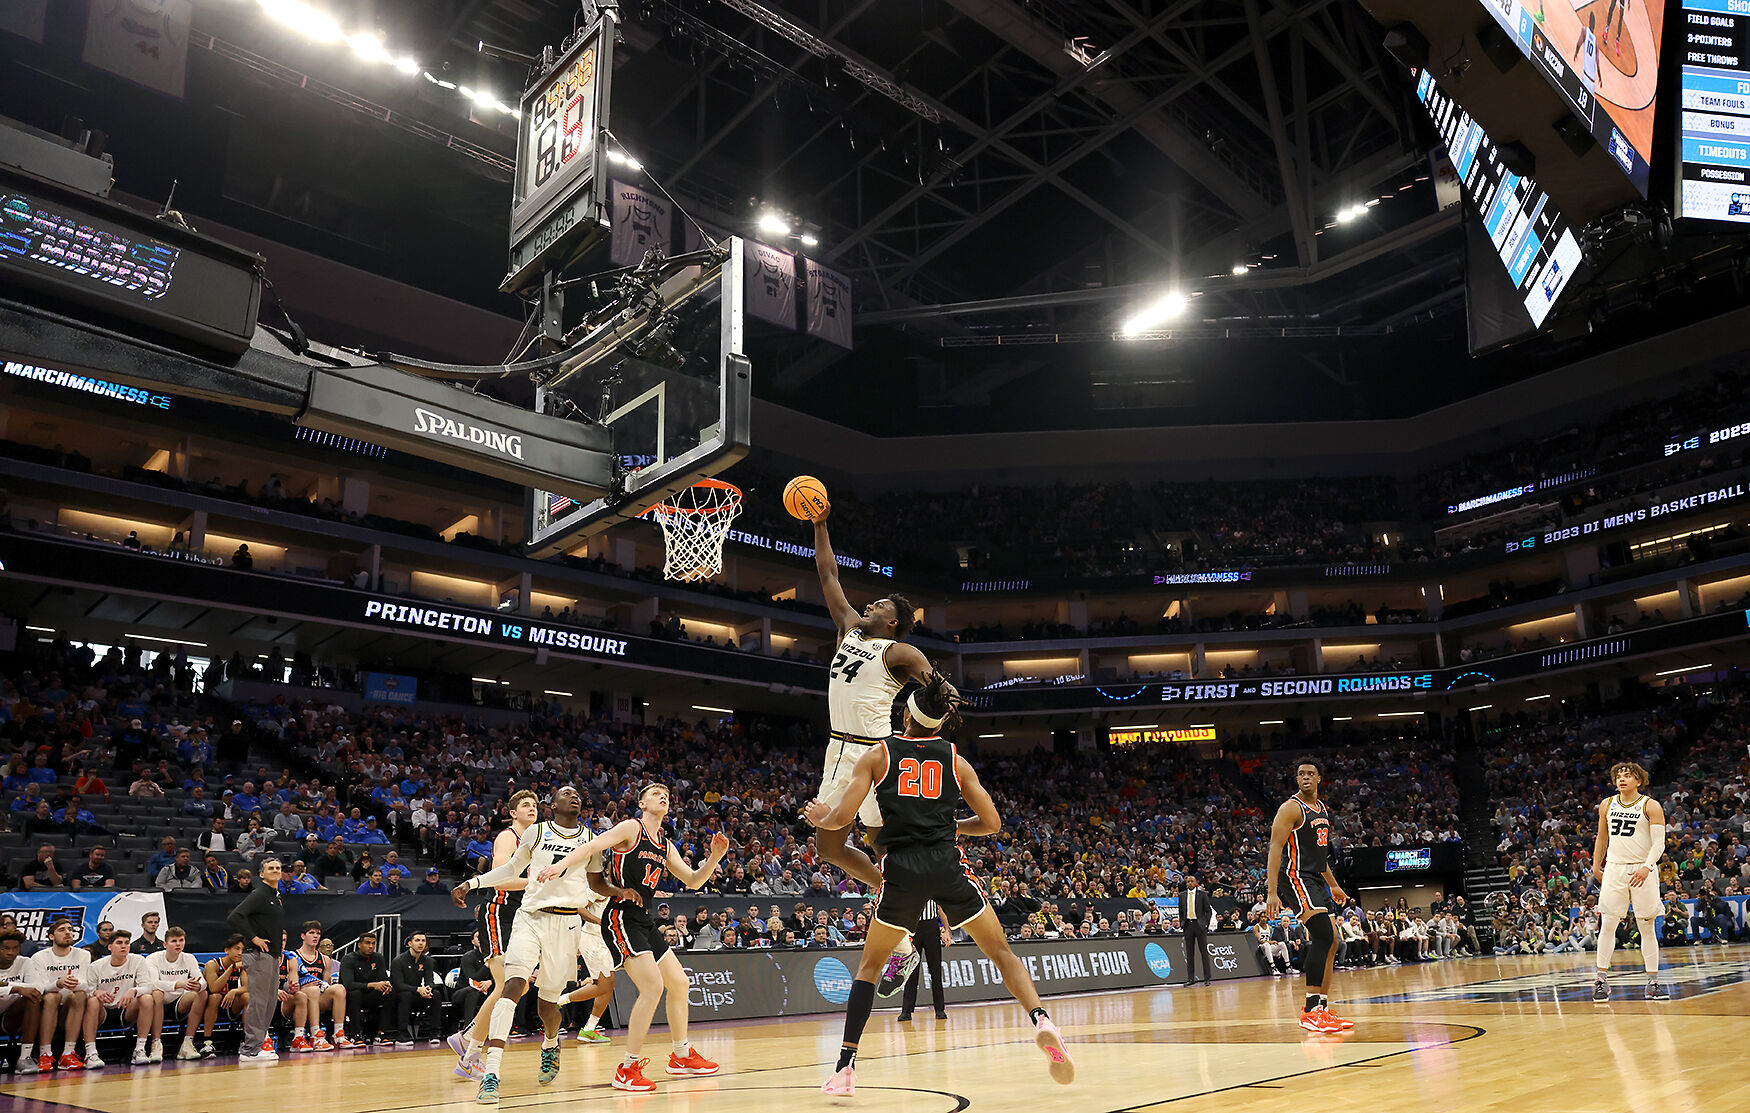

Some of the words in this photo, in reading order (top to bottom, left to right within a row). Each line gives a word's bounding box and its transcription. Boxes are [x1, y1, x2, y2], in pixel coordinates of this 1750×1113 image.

[1687, 14, 1709, 26] FIELD
[1711, 16, 1735, 28] GOALS
[1687, 33, 1733, 47] 3-POINTERS
[1687, 52, 1706, 63] FREE
[1707, 53, 1739, 66] THROWS
[1701, 96, 1721, 107] TEAM
[1722, 98, 1745, 109] FOULS
[1710, 119, 1735, 130] BONUS
[1699, 144, 1747, 160] TIMEOUTS
[1701, 168, 1745, 181] POSSESSION
[620, 192, 665, 216] RICHMOND
[757, 249, 781, 263] DIVAC
[414, 407, 523, 461] SPALDING
[1709, 423, 1750, 444] 2023
[1543, 526, 1580, 545] 2023
[1603, 509, 1647, 529] MEN'S
[1650, 484, 1745, 518] BASKETBALL
[365, 600, 492, 635] PRINCETON
[501, 623, 522, 640] VS
[528, 627, 628, 656] MISSOURI
[830, 652, 865, 684] 24
[1184, 684, 1239, 700] FIRST
[1260, 679, 1333, 697] SECOND
[1338, 676, 1412, 693] ROUNDS
[897, 757, 943, 800] 20
[1610, 811, 1642, 820] MIZZOU
[1610, 818, 1638, 837] 35
[1394, 851, 1418, 861] MARCH
[1398, 858, 1431, 867] MADNESS
[642, 863, 662, 889] 14
[1207, 943, 1235, 956] Great
[978, 958, 1002, 985] TO
[1041, 952, 1090, 980] FINAL
[1091, 950, 1132, 977] FOUR
[1150, 959, 1171, 970] NCAA
[1213, 956, 1236, 971] Clips
[682, 967, 735, 985] Great
[687, 987, 735, 1012] Clips
